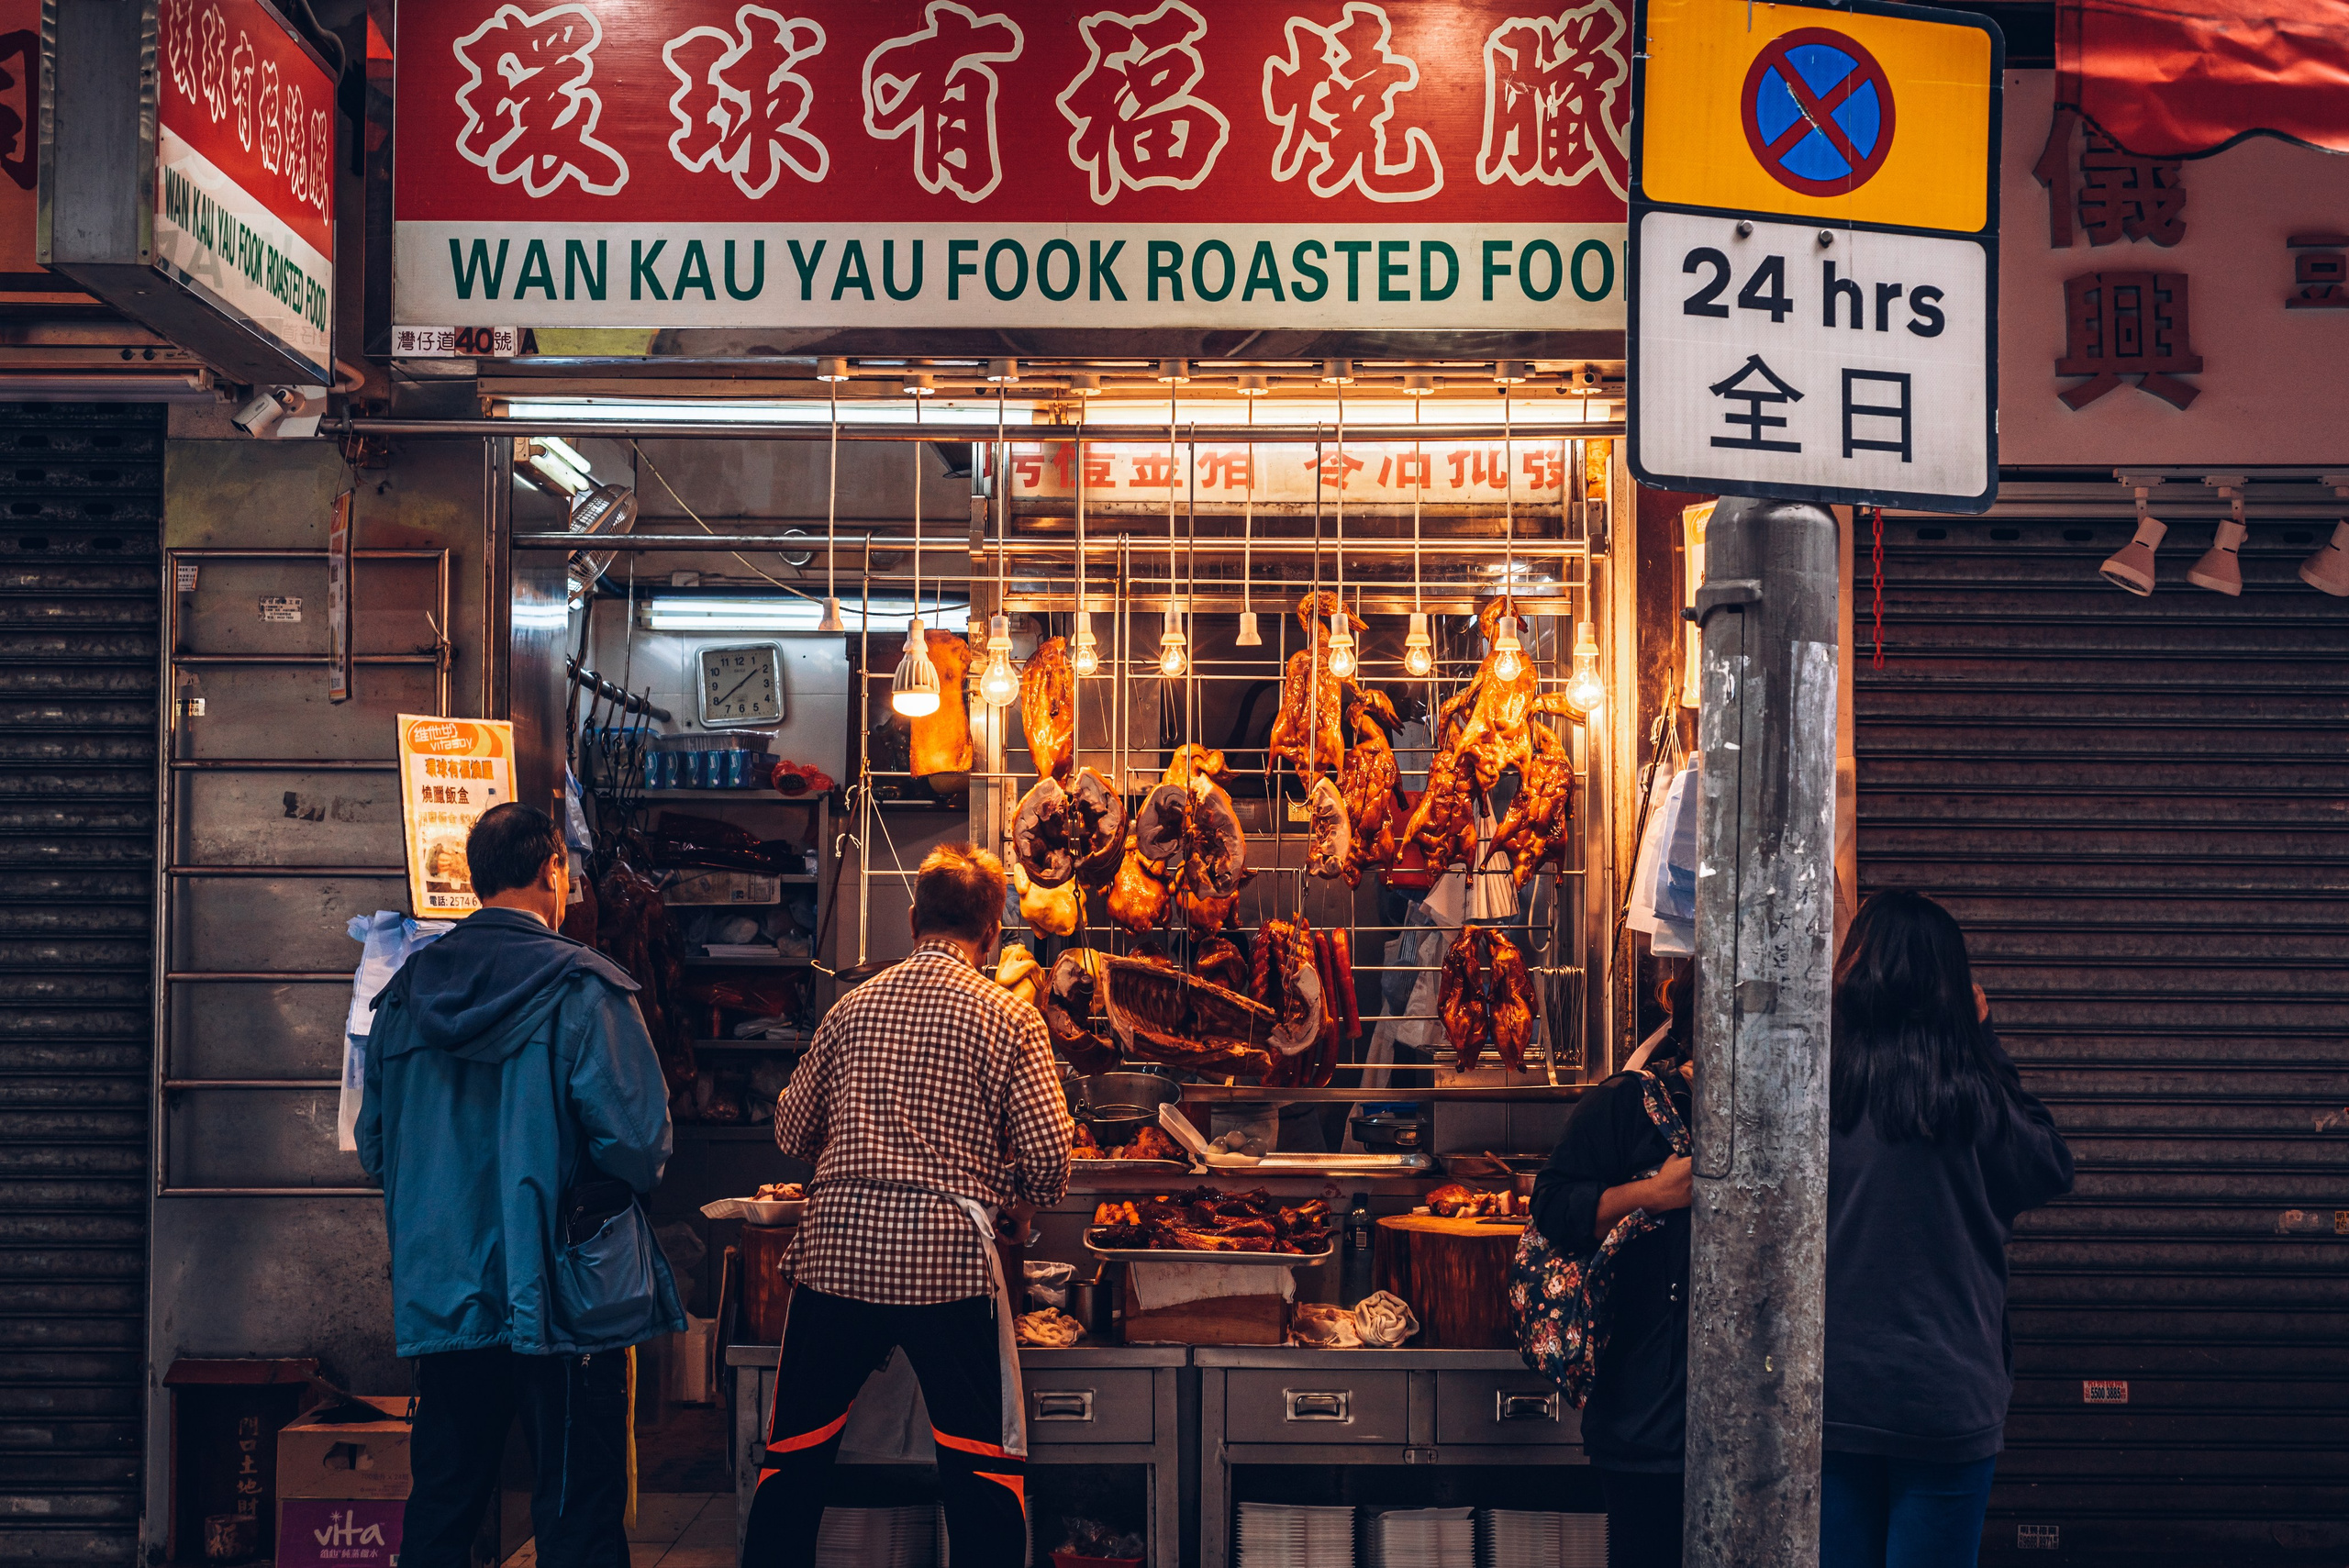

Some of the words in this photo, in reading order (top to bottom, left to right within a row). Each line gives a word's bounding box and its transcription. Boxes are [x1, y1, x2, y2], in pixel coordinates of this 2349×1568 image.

[165, 164, 189, 232] WAN
[193, 186, 215, 250] KAU
[217, 205, 236, 266] YAU
[239, 222, 264, 287] FOOK
[266, 244, 304, 315] ROASTED
[306, 275, 327, 332] FOOD
[450, 239, 607, 301] WAN
[631, 239, 765, 301] KAU
[786, 239, 925, 301] YAU
[949, 239, 1128, 302] FOOK
[1147, 239, 1460, 302] ROASTED
[1482, 239, 1628, 302] FOO
[1682, 246, 1793, 324] 24
[1822, 260, 1946, 338] hrs
[1709, 354, 1912, 463] 全日
[736, 657, 744, 665] 12
[710, 668, 719, 676] 10
[763, 664, 768, 673] 2
[712, 683, 718, 691] 9
[763, 679, 769, 687] 3
[713, 697, 718, 706] 8
[764, 695, 771, 703] 4
[726, 705, 730, 714] 7
[753, 703, 759, 711] 5
[413, 723, 458, 743] 維他奶
[429, 738, 473, 751] vitasoy
[450, 896, 470, 906] 2574
[314, 1509, 385, 1546] vita
